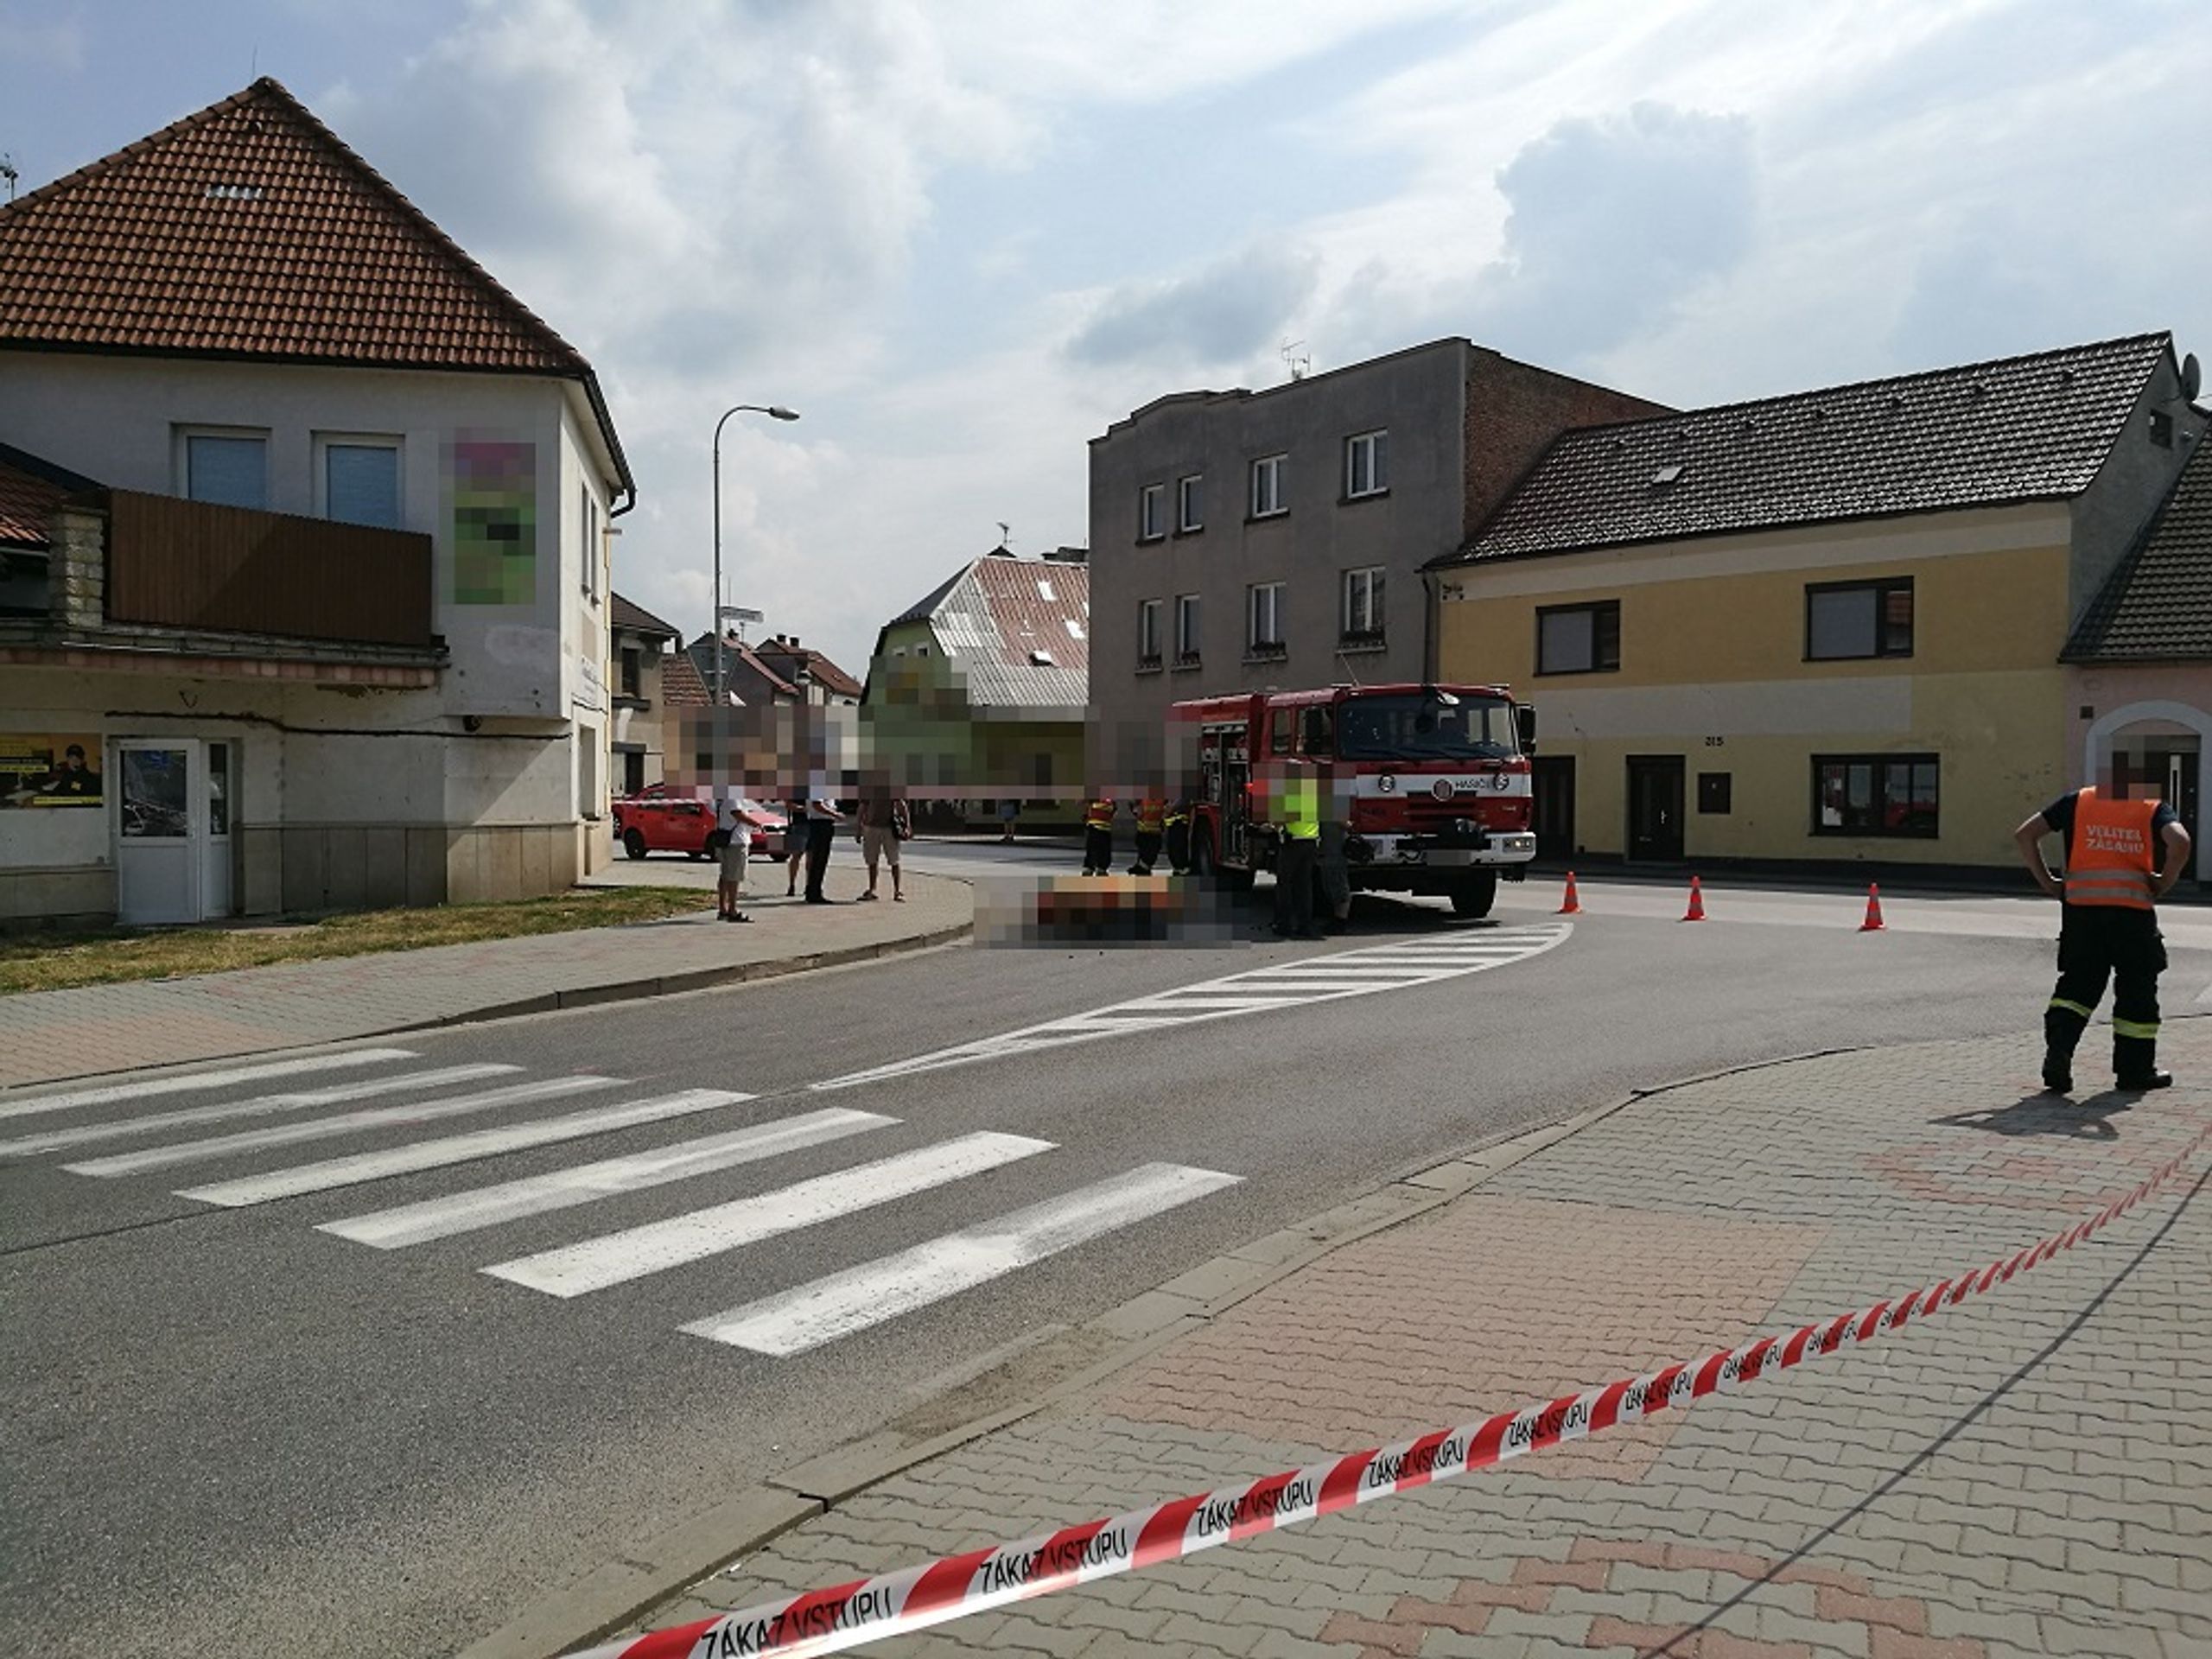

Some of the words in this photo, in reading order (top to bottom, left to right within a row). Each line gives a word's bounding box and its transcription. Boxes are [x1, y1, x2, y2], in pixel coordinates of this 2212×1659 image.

[2085, 824, 2143, 842] VELITEL
[1250, 1478, 1313, 1519] VSTUPU
[980, 1546, 1045, 1594] ZÁKAZ
[1050, 1528, 1128, 1573] VSTUPU
[701, 1611, 785, 1659] ZÁKAZ
[791, 1586, 893, 1639] VSTUPU
